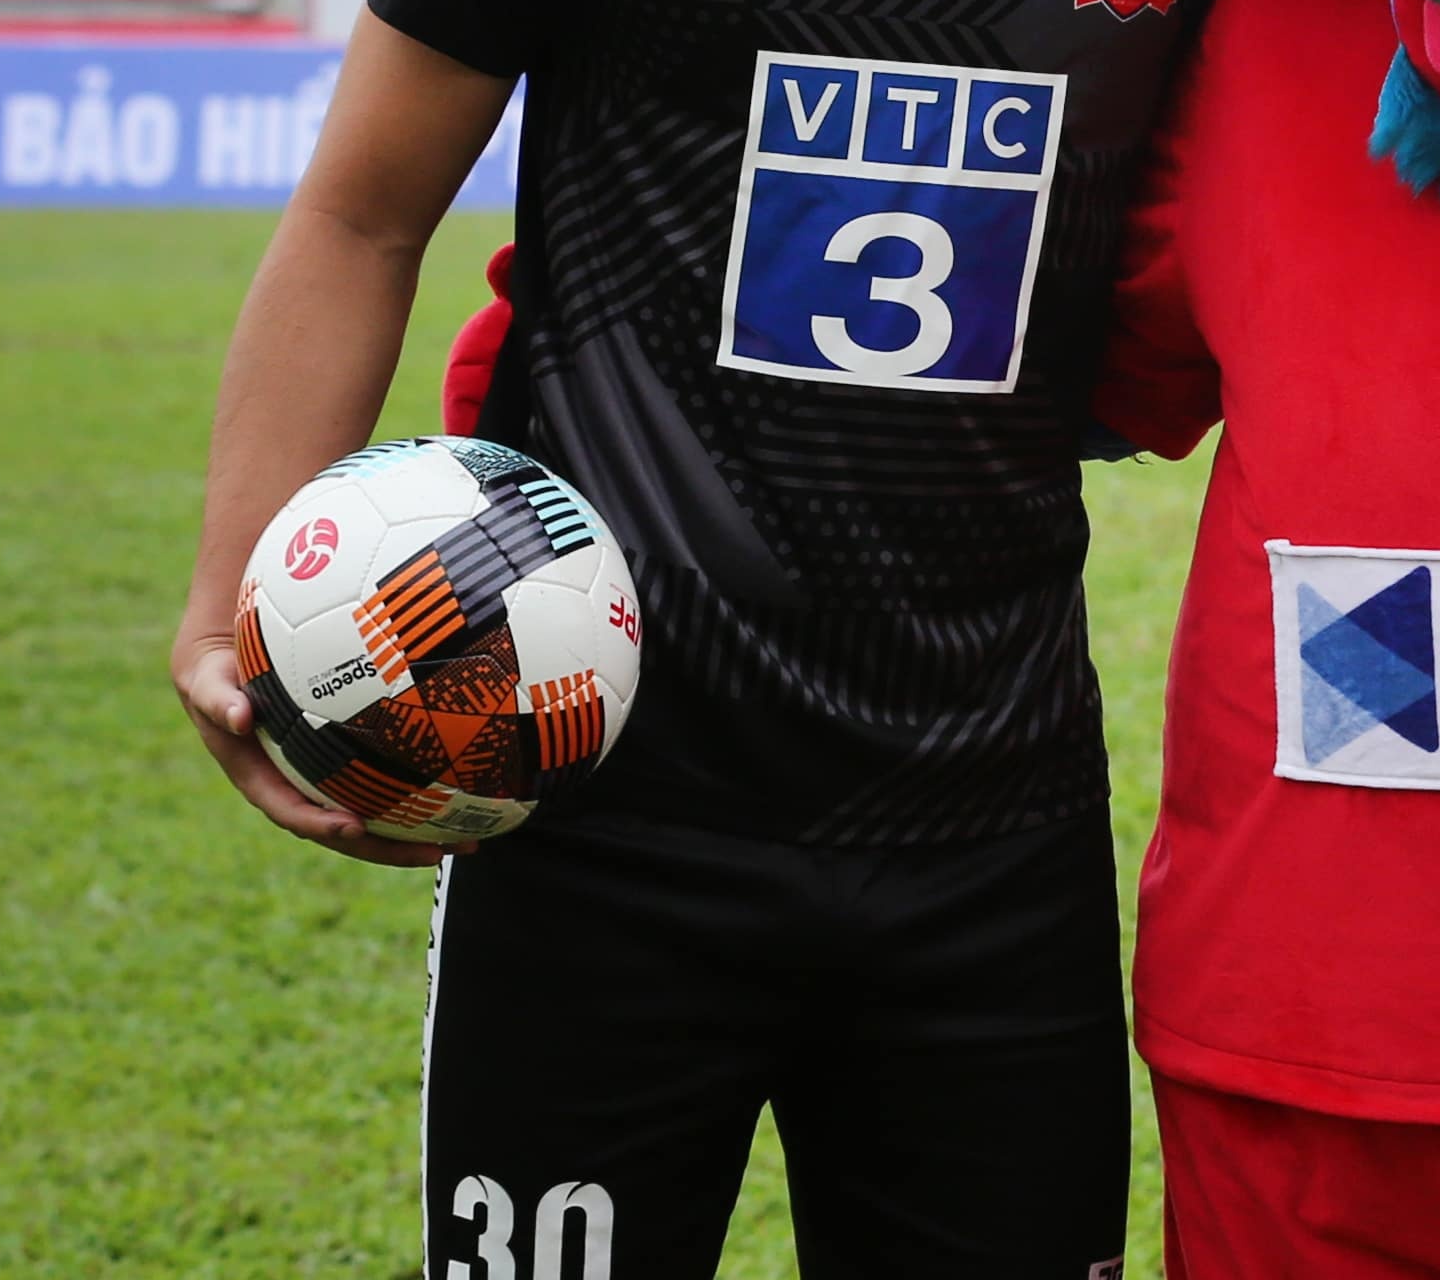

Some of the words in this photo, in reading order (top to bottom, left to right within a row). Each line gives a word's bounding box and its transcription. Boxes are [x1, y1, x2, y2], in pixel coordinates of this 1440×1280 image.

[0, 67, 178, 188] BẢO
[782, 78, 1032, 159] VTC
[810, 211, 955, 378] 3
[311, 661, 378, 701] Spectro
